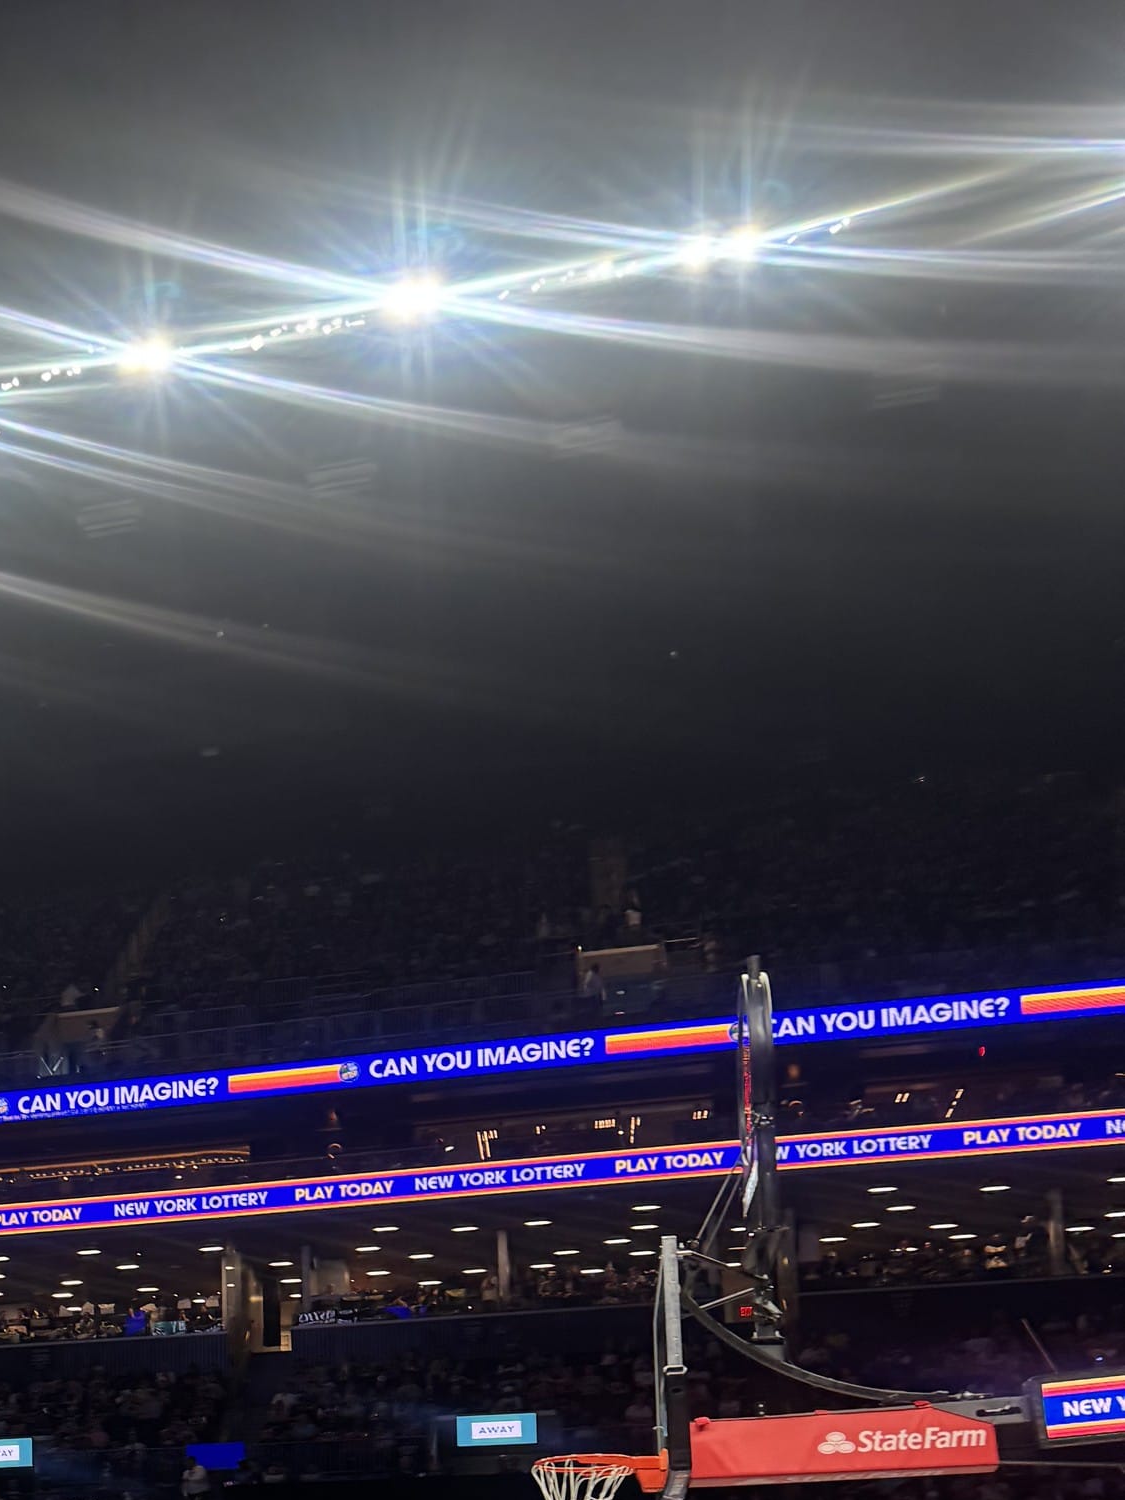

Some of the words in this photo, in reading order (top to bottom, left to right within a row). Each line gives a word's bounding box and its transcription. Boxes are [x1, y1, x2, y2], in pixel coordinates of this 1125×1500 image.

[820, 1009, 875, 1033] YOU
[881, 997, 1010, 1028] IMAGINE?
[369, 1056, 417, 1079] CAN
[423, 1050, 471, 1073] YOU
[477, 1037, 595, 1067] IMAGINE?
[18, 1092, 61, 1115] CAN
[65, 1088, 110, 1110] YOU
[115, 1077, 219, 1105] IMAGINE?
[795, 1141, 847, 1158] YORK
[853, 1134, 932, 1155] LOTTERY
[963, 1127, 1010, 1146] PLAY
[1015, 1122, 1081, 1142] TODAY
[615, 1156, 659, 1174] PLAY
[663, 1151, 725, 1169] TODAY
[414, 1174, 455, 1191] NEW
[459, 1169, 507, 1188] YORK
[512, 1163, 586, 1183] LOTTERY
[294, 1185, 335, 1202] PLAY
[339, 1180, 393, 1198] TODAY
[32, 1207, 82, 1223] TODAY
[114, 1201, 149, 1217] NEW
[153, 1197, 196, 1214] YORK
[202, 1190, 268, 1210] LOTTERY
[1062, 1397, 1113, 1417] NEW
[478, 1425, 515, 1434] AWAY
